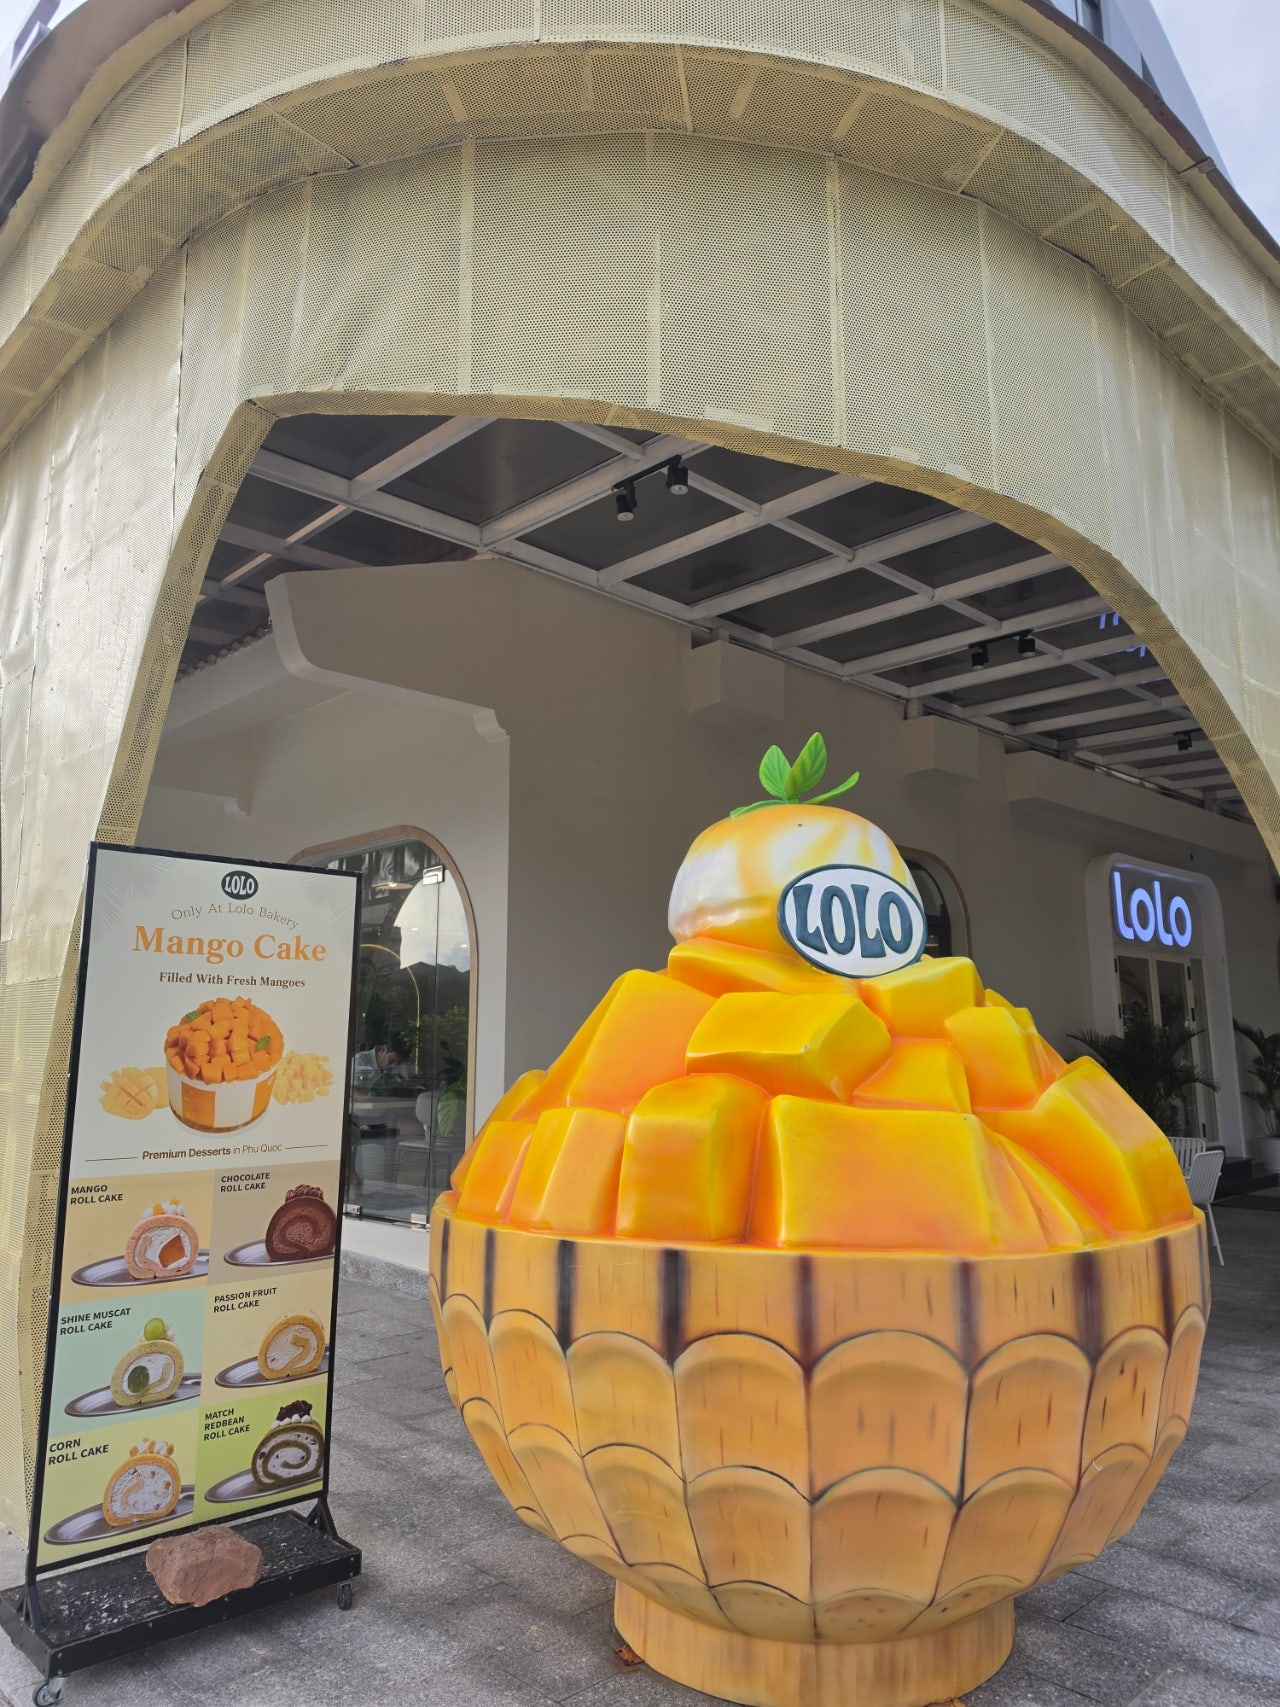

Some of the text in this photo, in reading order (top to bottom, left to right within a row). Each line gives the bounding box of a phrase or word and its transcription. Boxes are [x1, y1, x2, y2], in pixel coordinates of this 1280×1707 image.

[224, 875, 255, 895] LOLO
[171, 903, 299, 930] Only At Lolo Bakery
[793, 883, 913, 958] LOLO
[132, 925, 327, 965] Mango Cake
[159, 971, 306, 989] Filled With Fresh Mangoes
[142, 1149, 187, 1160] Premium
[188, 1146, 231, 1158] Desserts
[232, 1145, 241, 1155] in
[242, 1144, 259, 1154] Phu
[221, 1172, 270, 1183] CHOCOLATE
[71, 1184, 108, 1194] MANGO
[220, 1182, 266, 1193] ROLL CAKE
[70, 1193, 124, 1205] ROLL CAKE
[214, 1287, 278, 1303] PASSION FRUIT
[213, 1299, 260, 1313] ROLL CAKE
[60, 1307, 131, 1325] SHINE MUSCAT
[59, 1320, 113, 1336] ROLL CAKE
[205, 1408, 235, 1420] MATCH
[204, 1415, 245, 1431] REDBEAN
[203, 1424, 251, 1441] ROLL CAKE
[49, 1438, 81, 1453] CORN
[48, 1444, 110, 1466] ROLL CAKE
